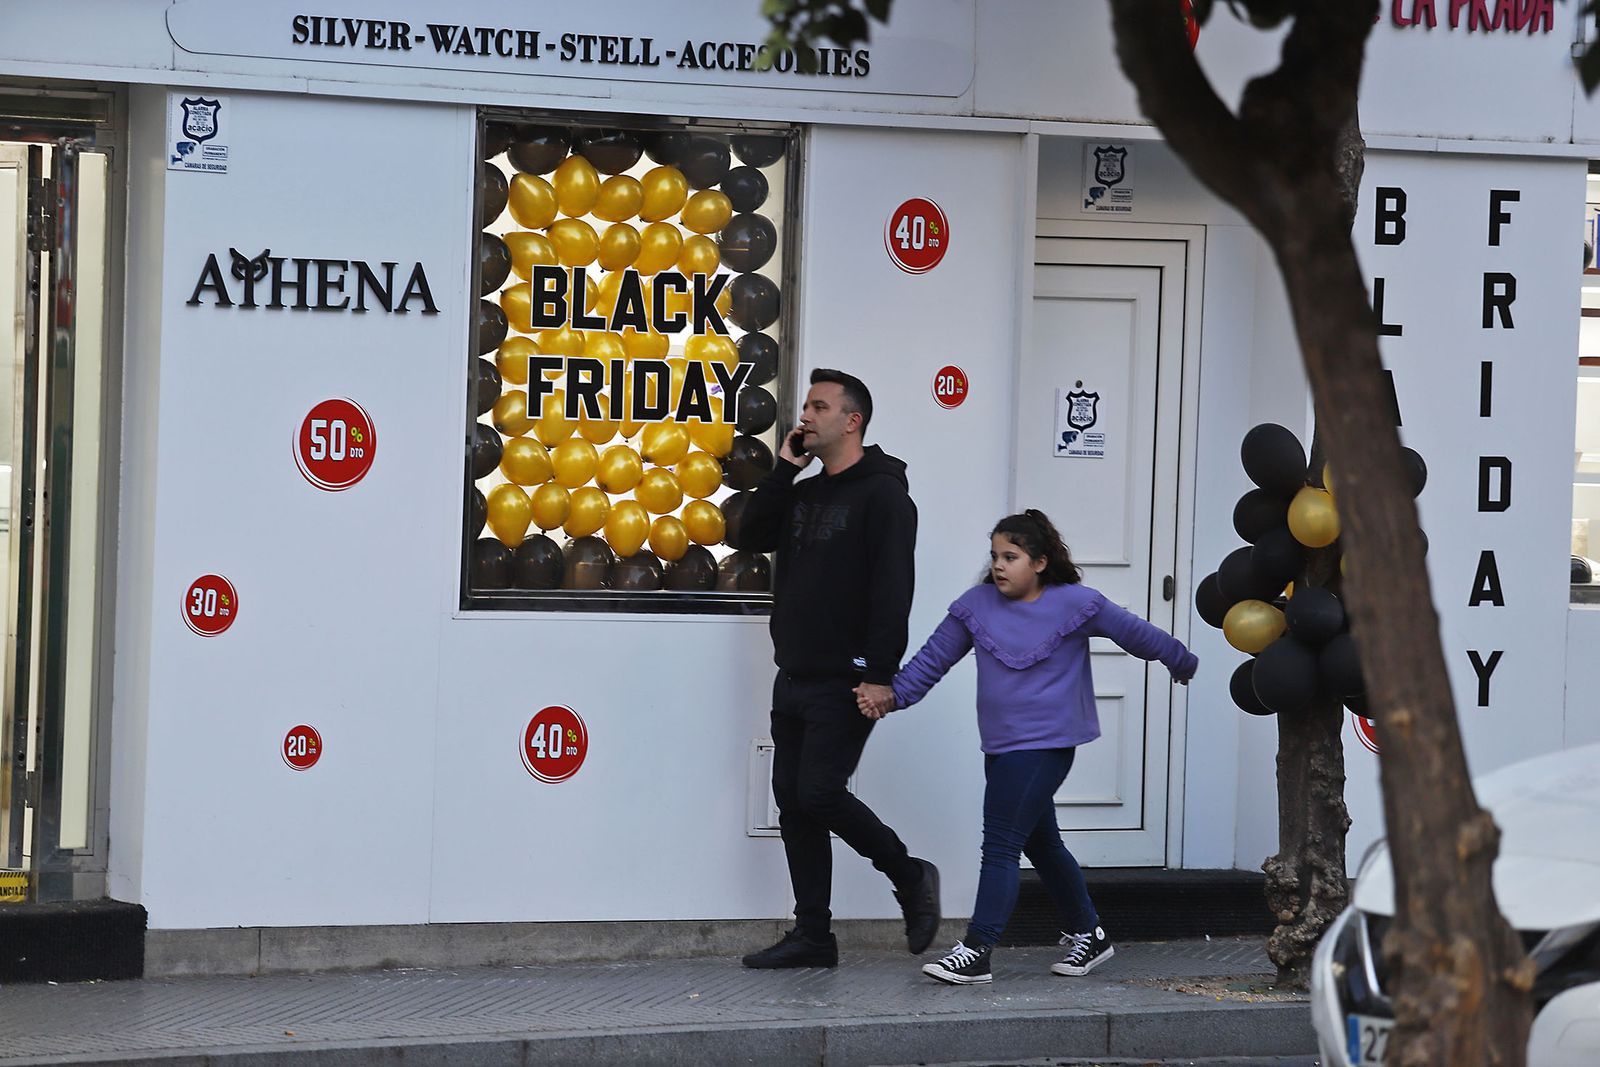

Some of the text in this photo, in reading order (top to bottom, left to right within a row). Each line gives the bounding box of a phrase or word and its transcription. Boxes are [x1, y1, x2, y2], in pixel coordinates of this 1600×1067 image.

[188, 124, 213, 132] acacio
[186, 247, 441, 314] ATHENA
[531, 264, 733, 336] BLACK
[526, 355, 756, 425] FRIDAY
[350, 447, 365, 459] DTO
[566, 746, 578, 756] DTO
